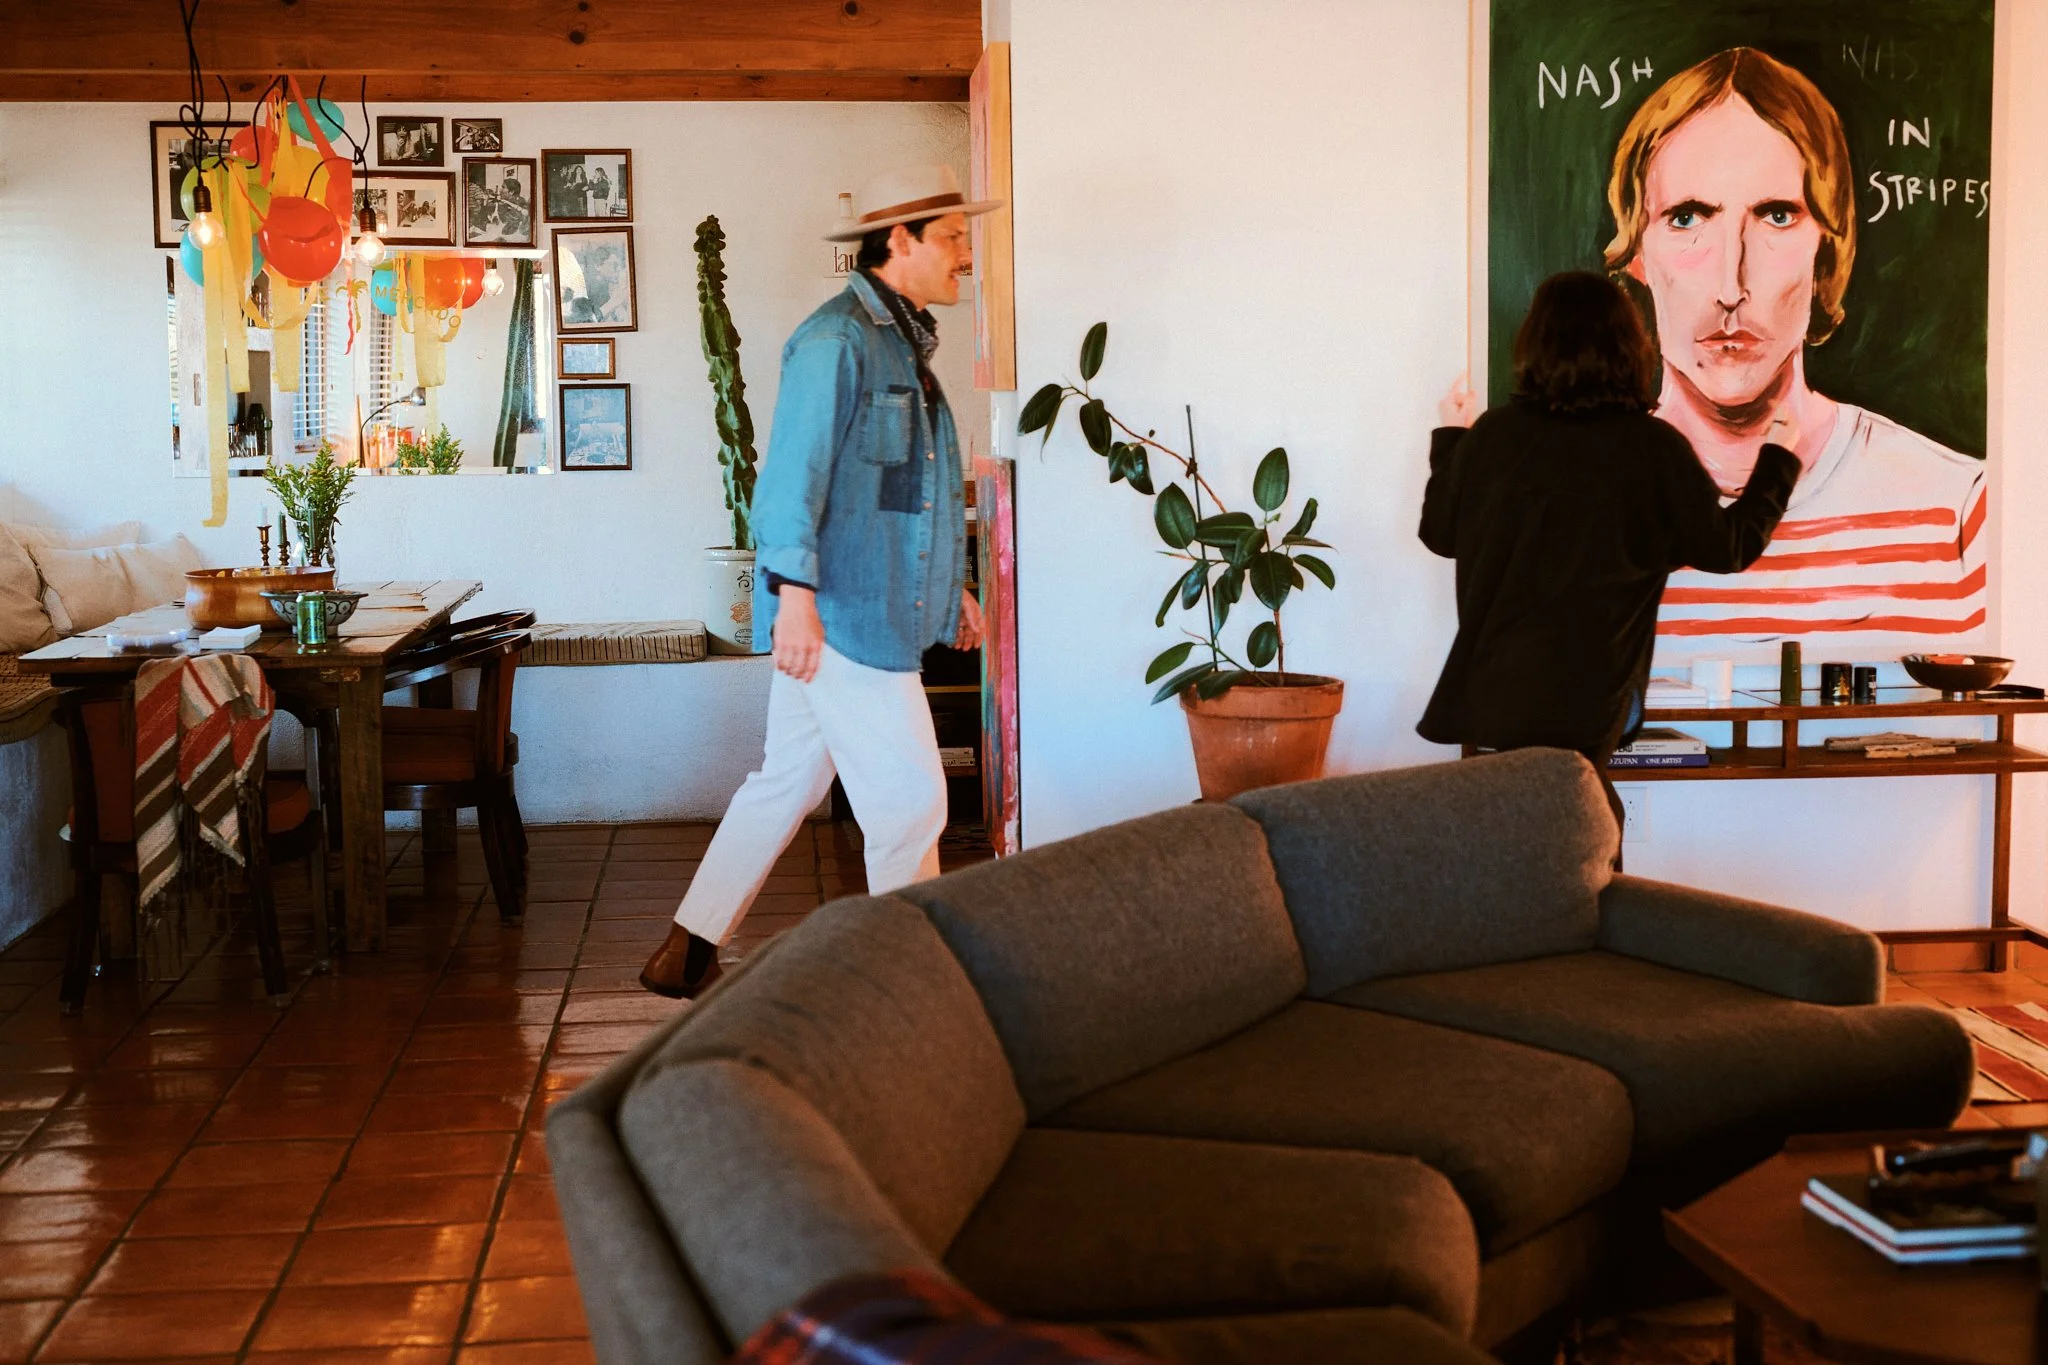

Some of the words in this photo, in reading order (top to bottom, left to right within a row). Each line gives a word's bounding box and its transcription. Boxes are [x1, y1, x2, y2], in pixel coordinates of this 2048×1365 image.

[1538, 56, 1654, 109] NASH
[1888, 117, 1930, 148] IN
[1867, 171, 1990, 223] STRIPES
[1645, 757, 1660, 765] ONE
[1661, 757, 1683, 765] ARTIST
